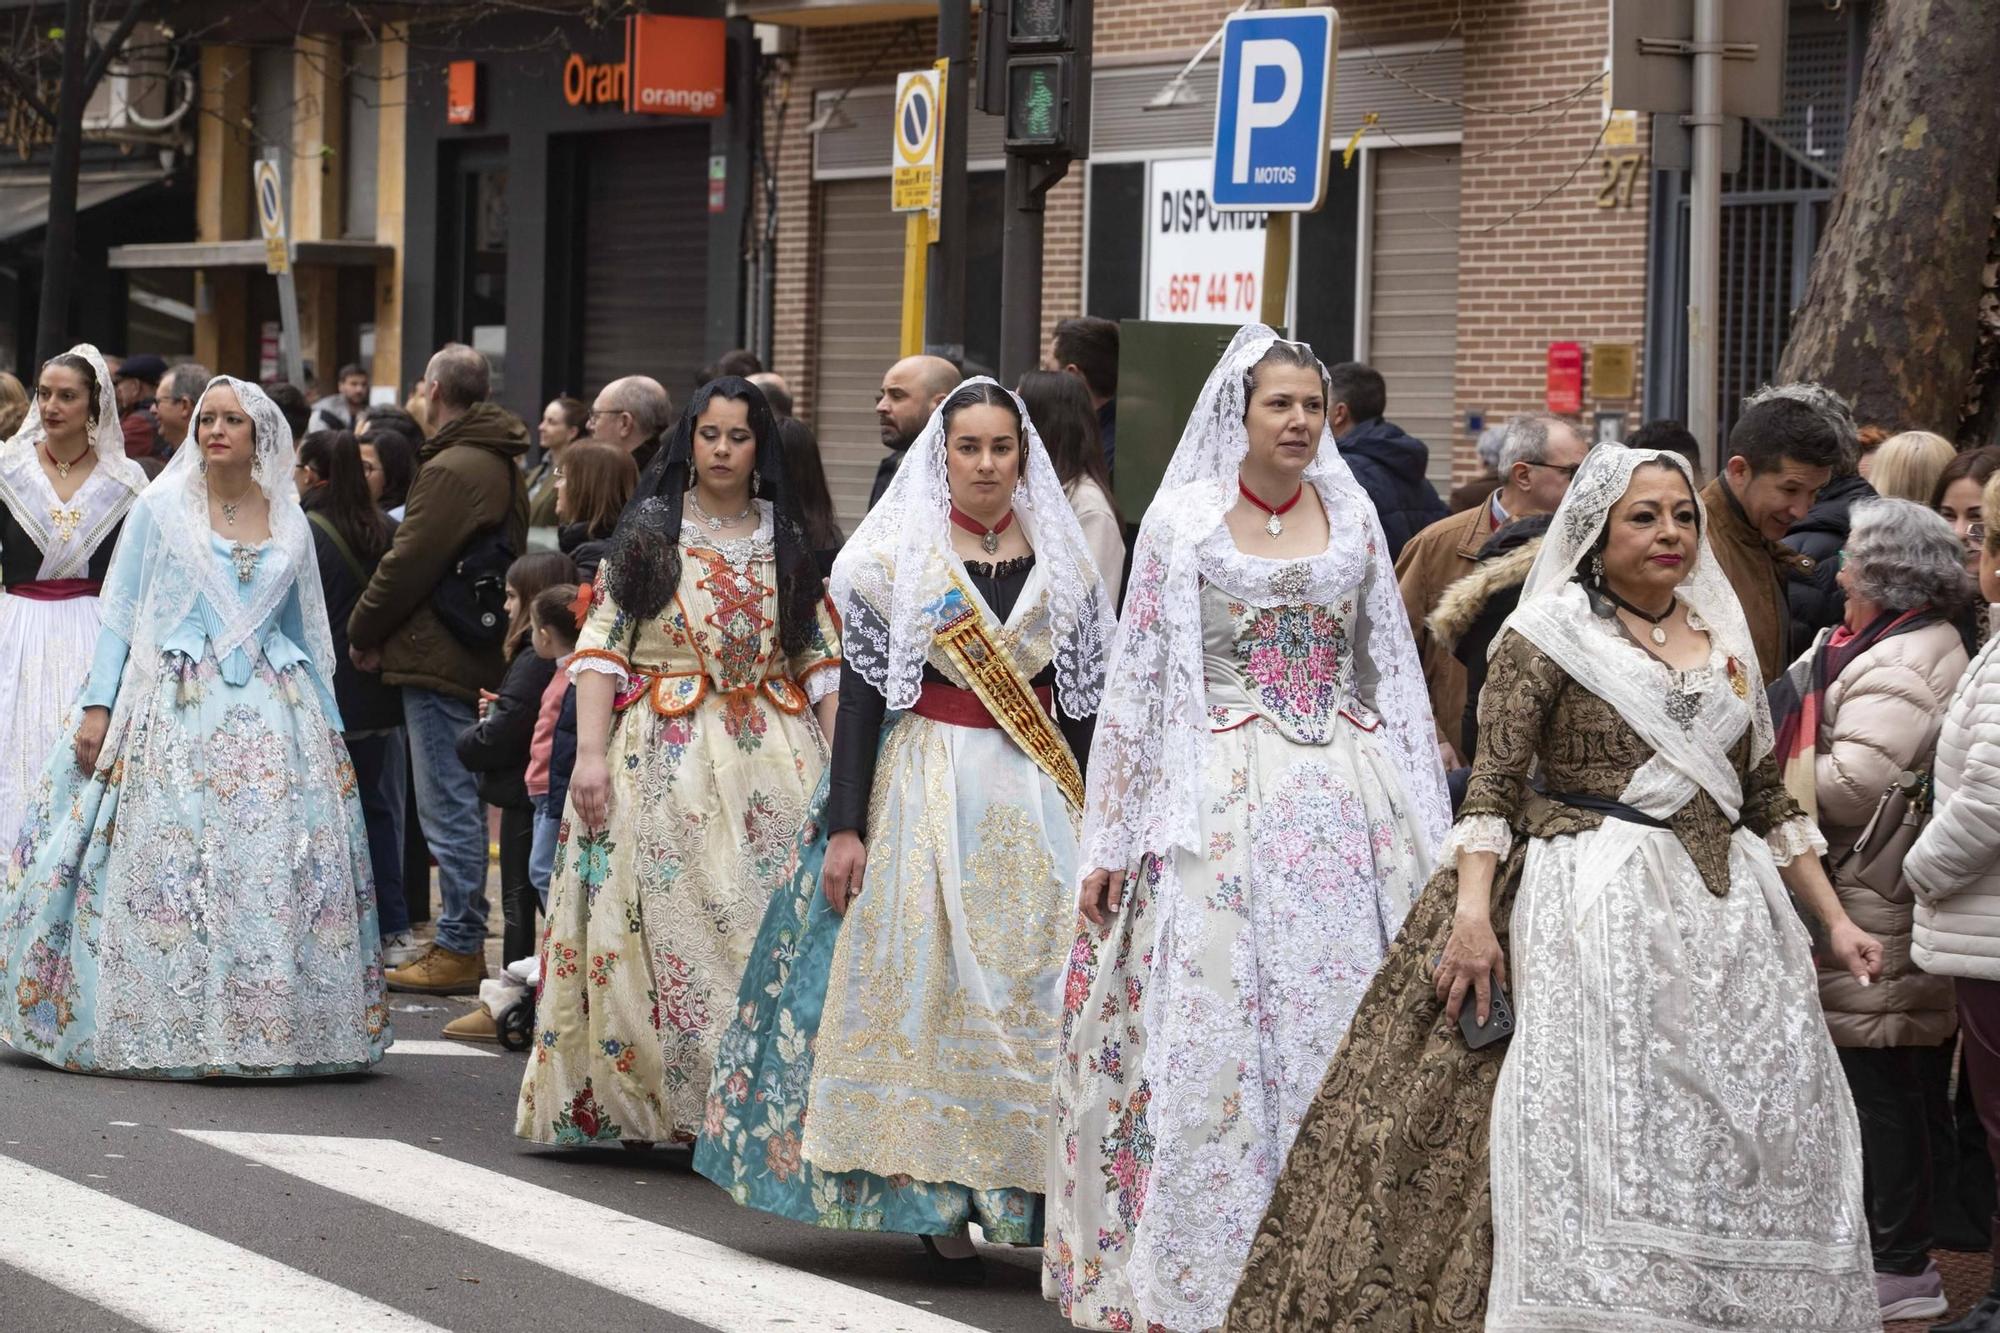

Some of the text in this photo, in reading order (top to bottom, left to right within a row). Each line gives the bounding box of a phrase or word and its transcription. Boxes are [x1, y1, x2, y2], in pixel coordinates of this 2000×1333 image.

[563, 53, 628, 105] Oran
[641, 87, 716, 112] orange
[1232, 39, 1303, 184] P
[1254, 166, 1296, 184] MOTOS
[1597, 153, 1643, 208] 27
[1161, 189, 1268, 233] DISPO
[1169, 271, 1255, 313] 667 44 70
